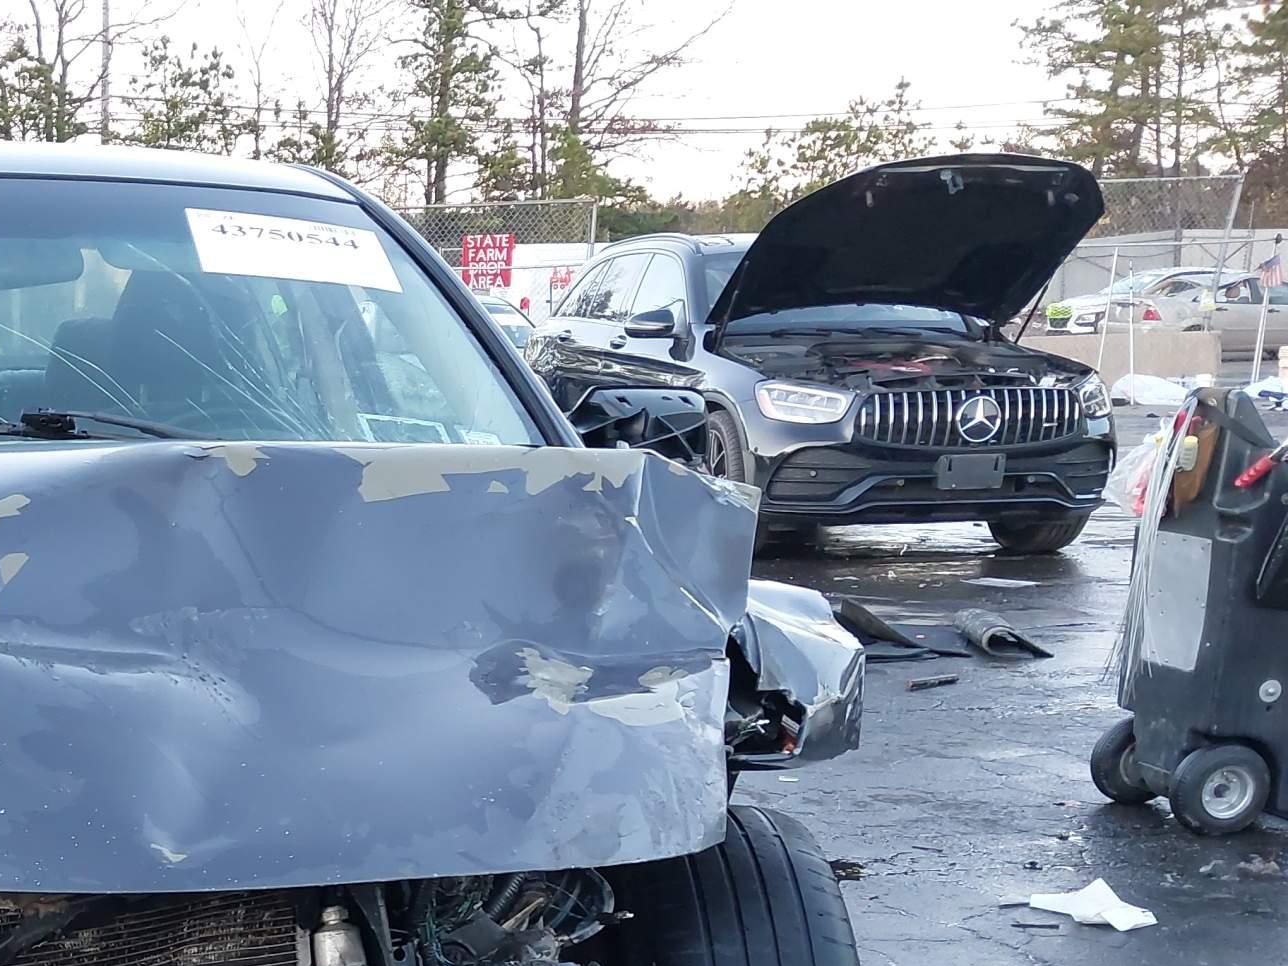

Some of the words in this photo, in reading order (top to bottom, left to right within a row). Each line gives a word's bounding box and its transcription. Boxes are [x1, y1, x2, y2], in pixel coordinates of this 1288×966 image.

[211, 223, 361, 250] 43750544
[466, 234, 510, 248] STATE
[468, 248, 508, 262] FARM
[468, 261, 506, 275] DROP
[468, 275, 505, 289] AREA
